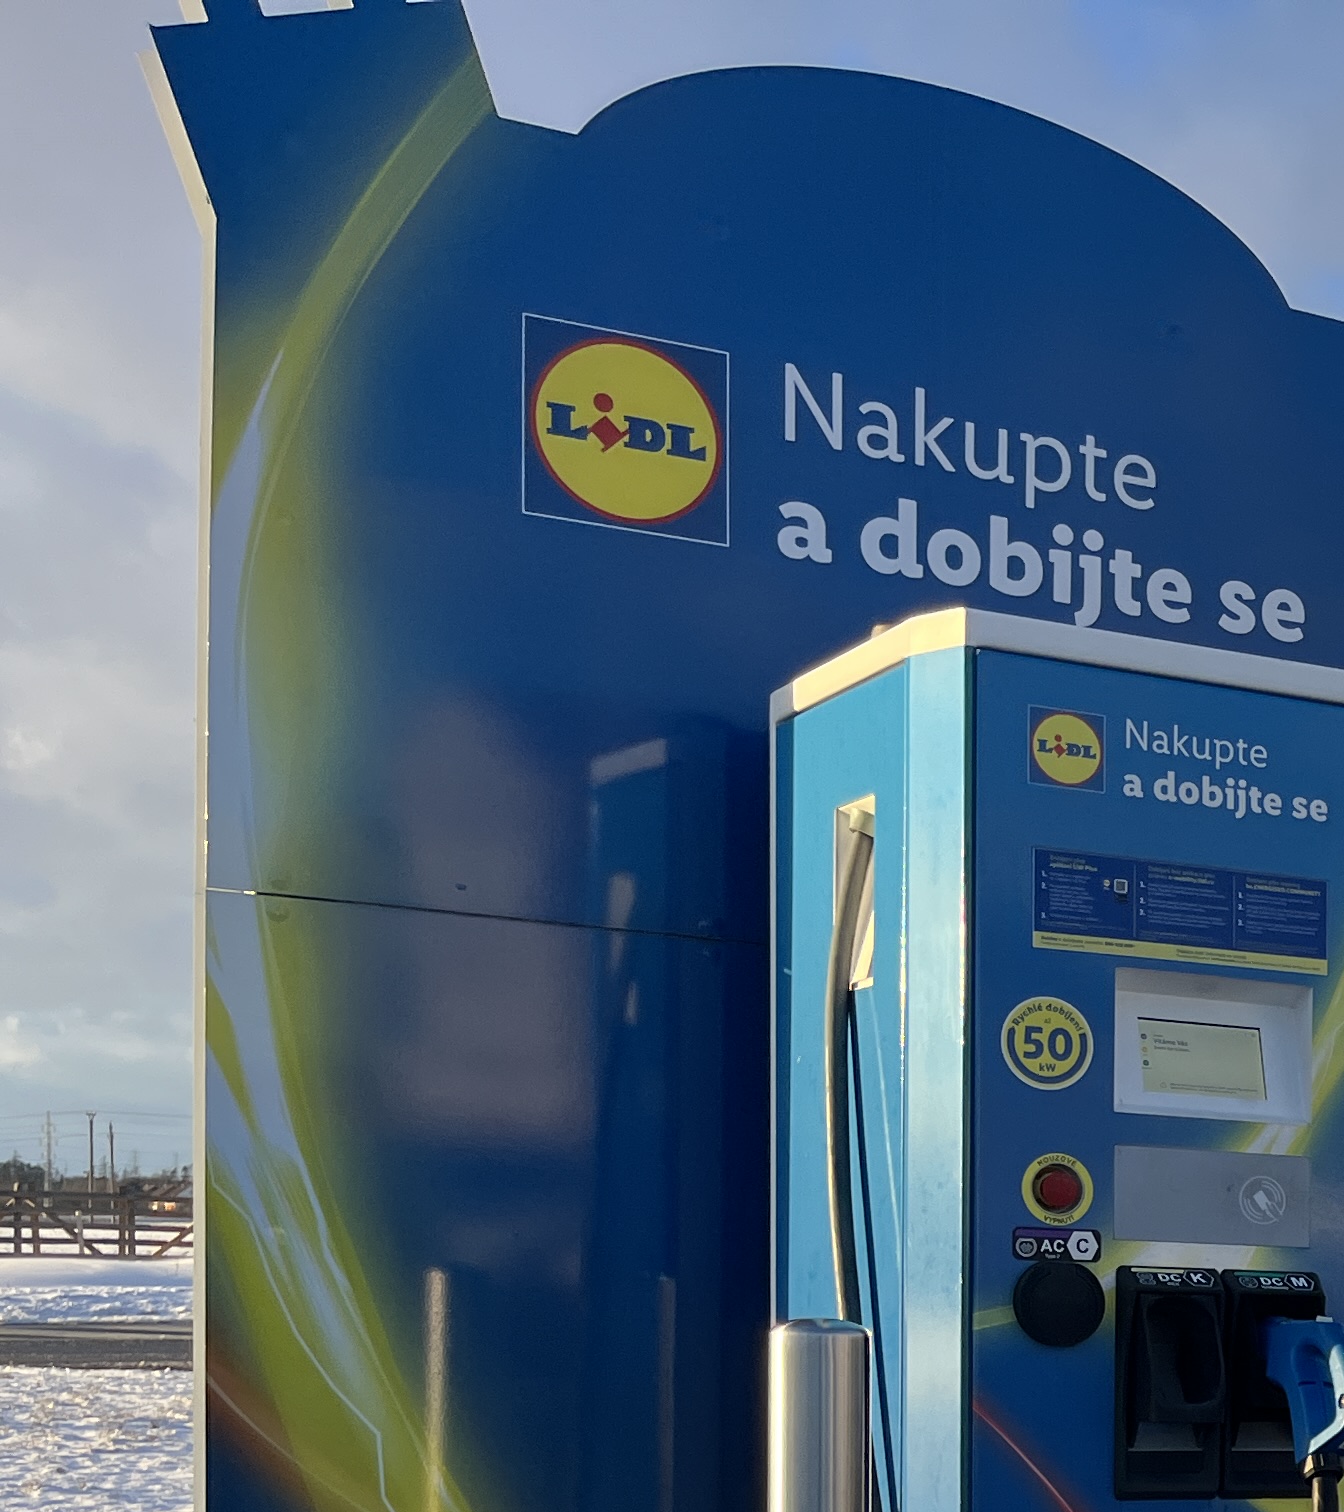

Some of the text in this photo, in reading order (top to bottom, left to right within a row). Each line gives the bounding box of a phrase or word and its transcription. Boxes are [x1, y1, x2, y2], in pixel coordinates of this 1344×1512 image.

[783, 362, 1159, 512] Nakupte
[777, 497, 1307, 644] a dobijte se
[1124, 717, 1269, 771] Nakupte
[1122, 770, 1329, 822] a dobijte se
[1012, 1003, 1043, 1026] Rychlé
[1023, 1025, 1073, 1062] 50
[1039, 1062, 1057, 1073] kW
[1040, 1238, 1090, 1253] AC C
[1157, 1272, 1208, 1283] DC K
[1259, 1277, 1308, 1287] DC M
